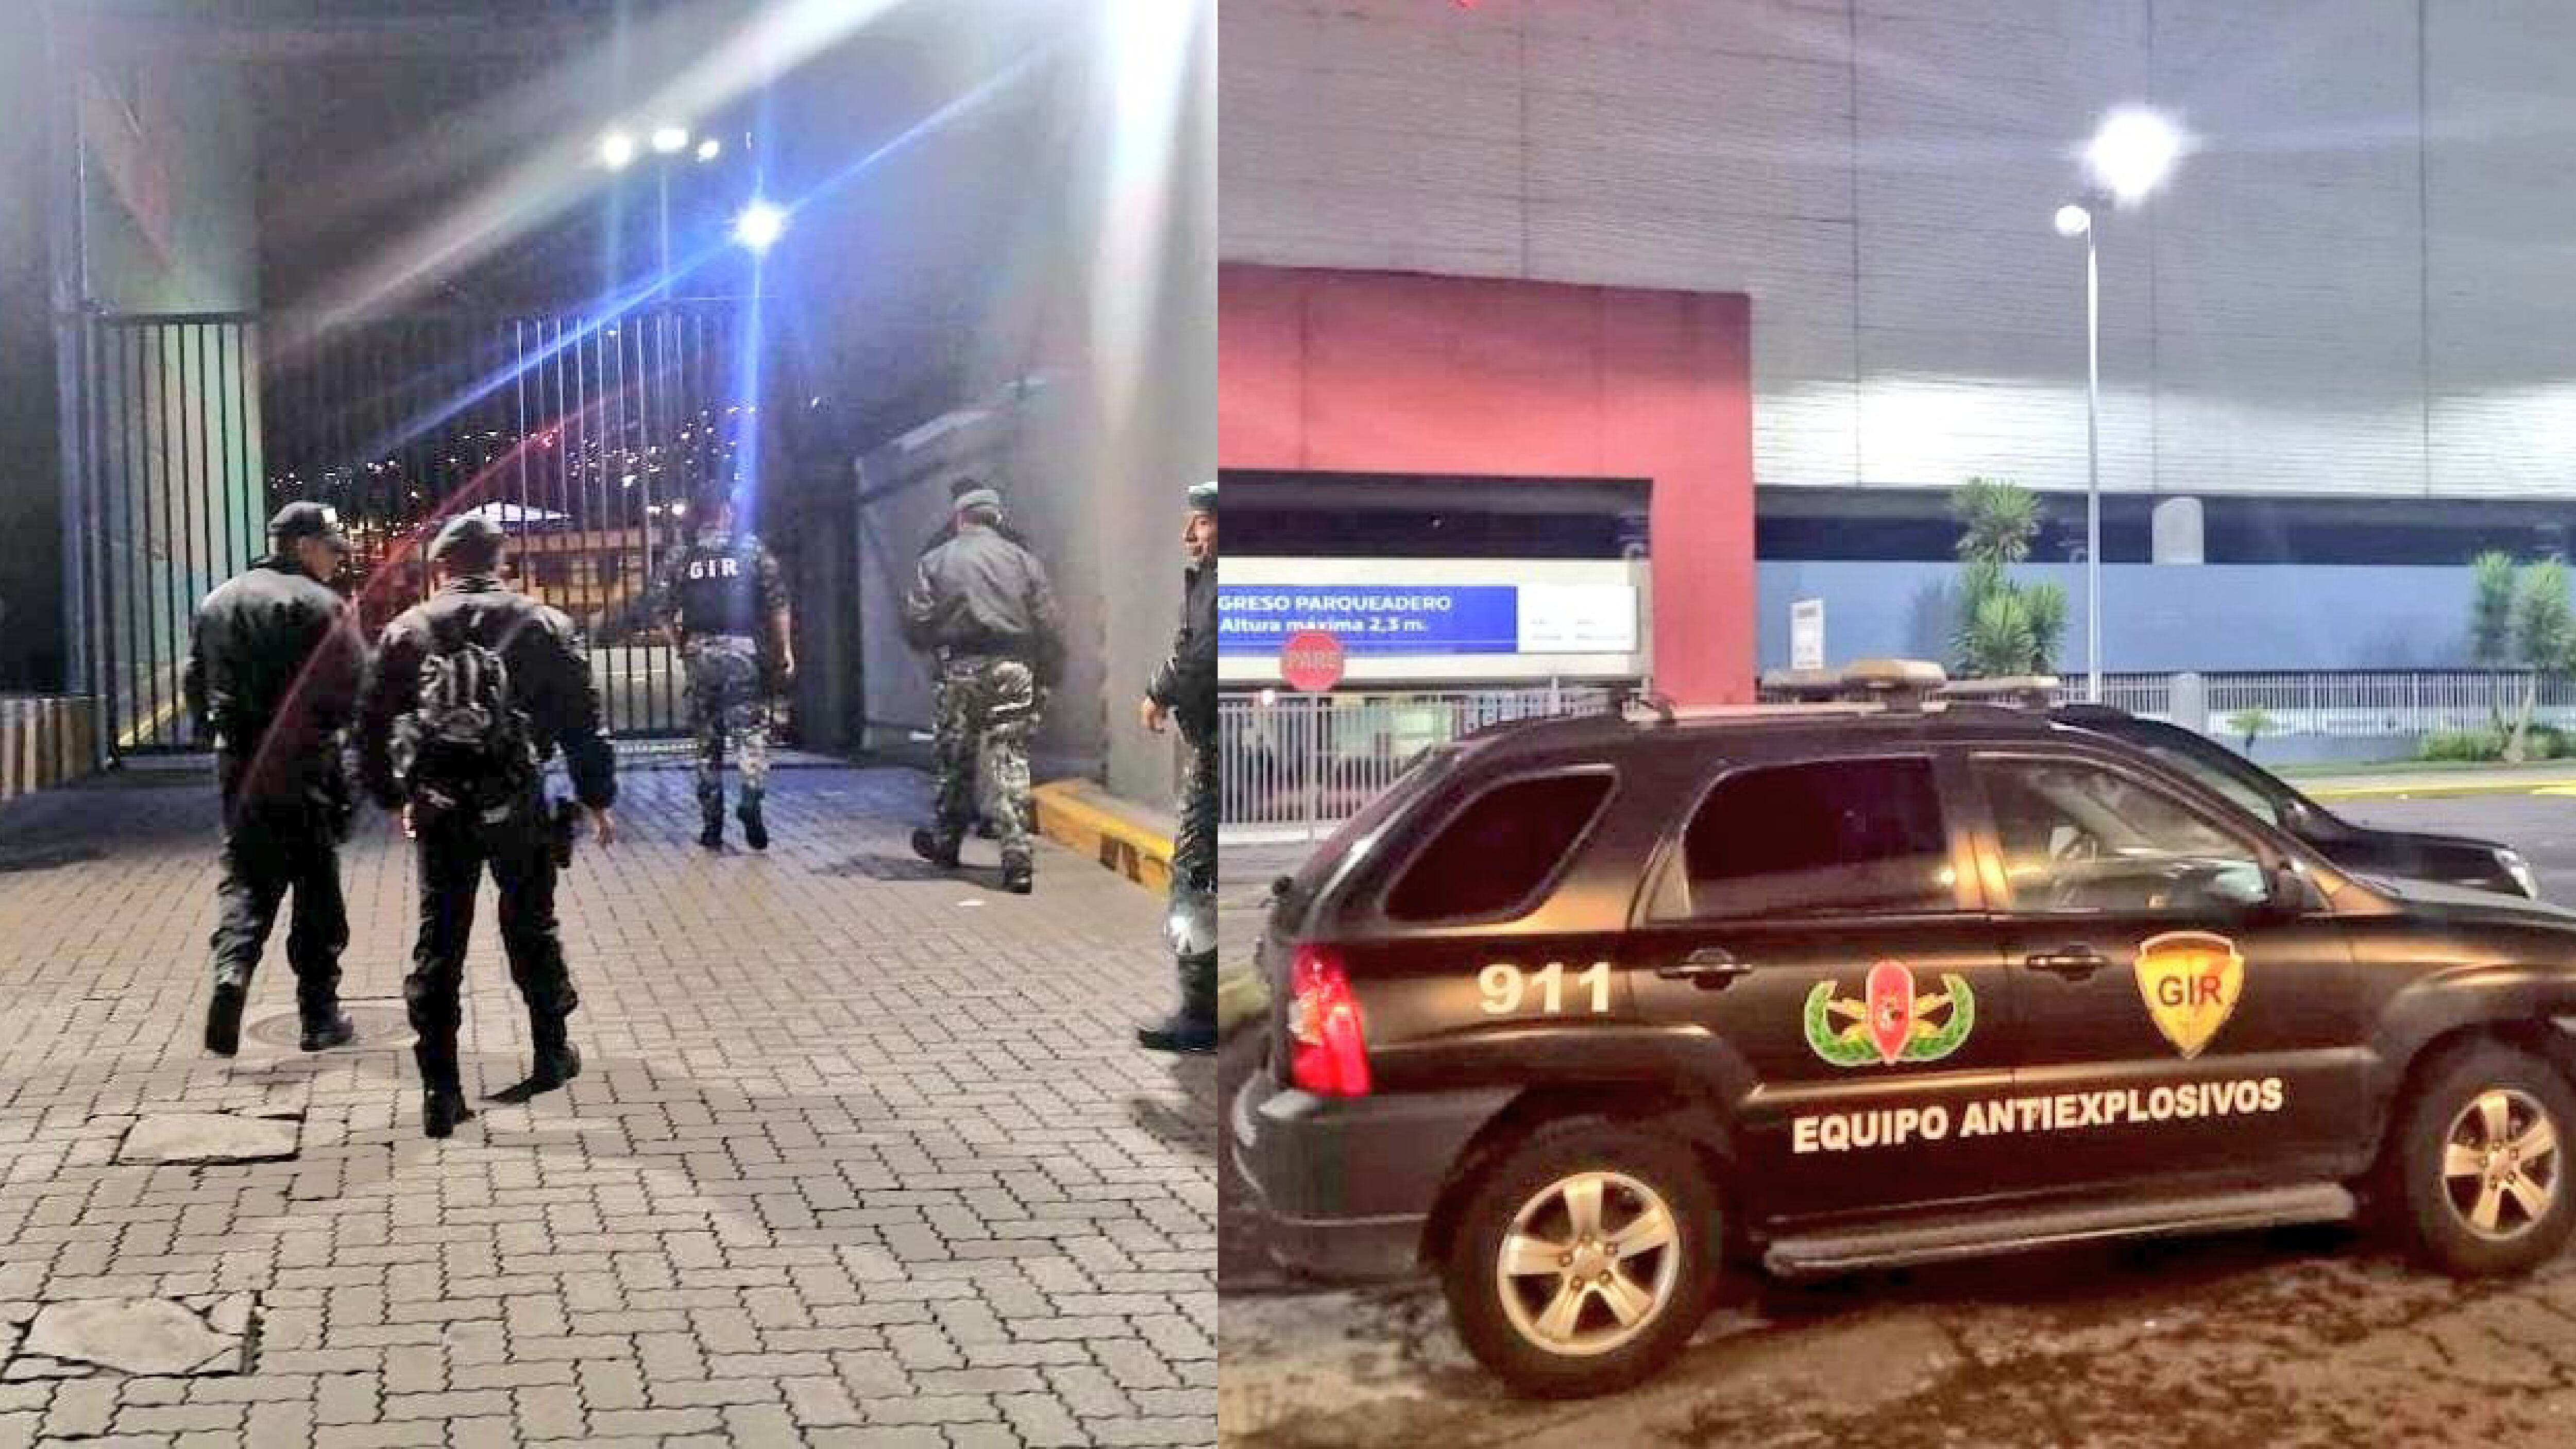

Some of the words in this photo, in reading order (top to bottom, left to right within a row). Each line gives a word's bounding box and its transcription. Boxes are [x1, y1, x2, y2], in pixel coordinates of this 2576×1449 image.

[690, 558, 738, 578] GIR
[1218, 595, 1289, 610] GRESO
[1295, 595, 1452, 612] PARQUEADERO
[1220, 618, 1281, 632] Altura
[1287, 651, 1341, 671] PARE
[1478, 962, 1611, 1014] 911
[2158, 975, 2223, 1007] GIR
[1793, 1105, 1947, 1153] EQUIPO
[1959, 1077, 2283, 1136] ANTIEXPLOSIVOS
